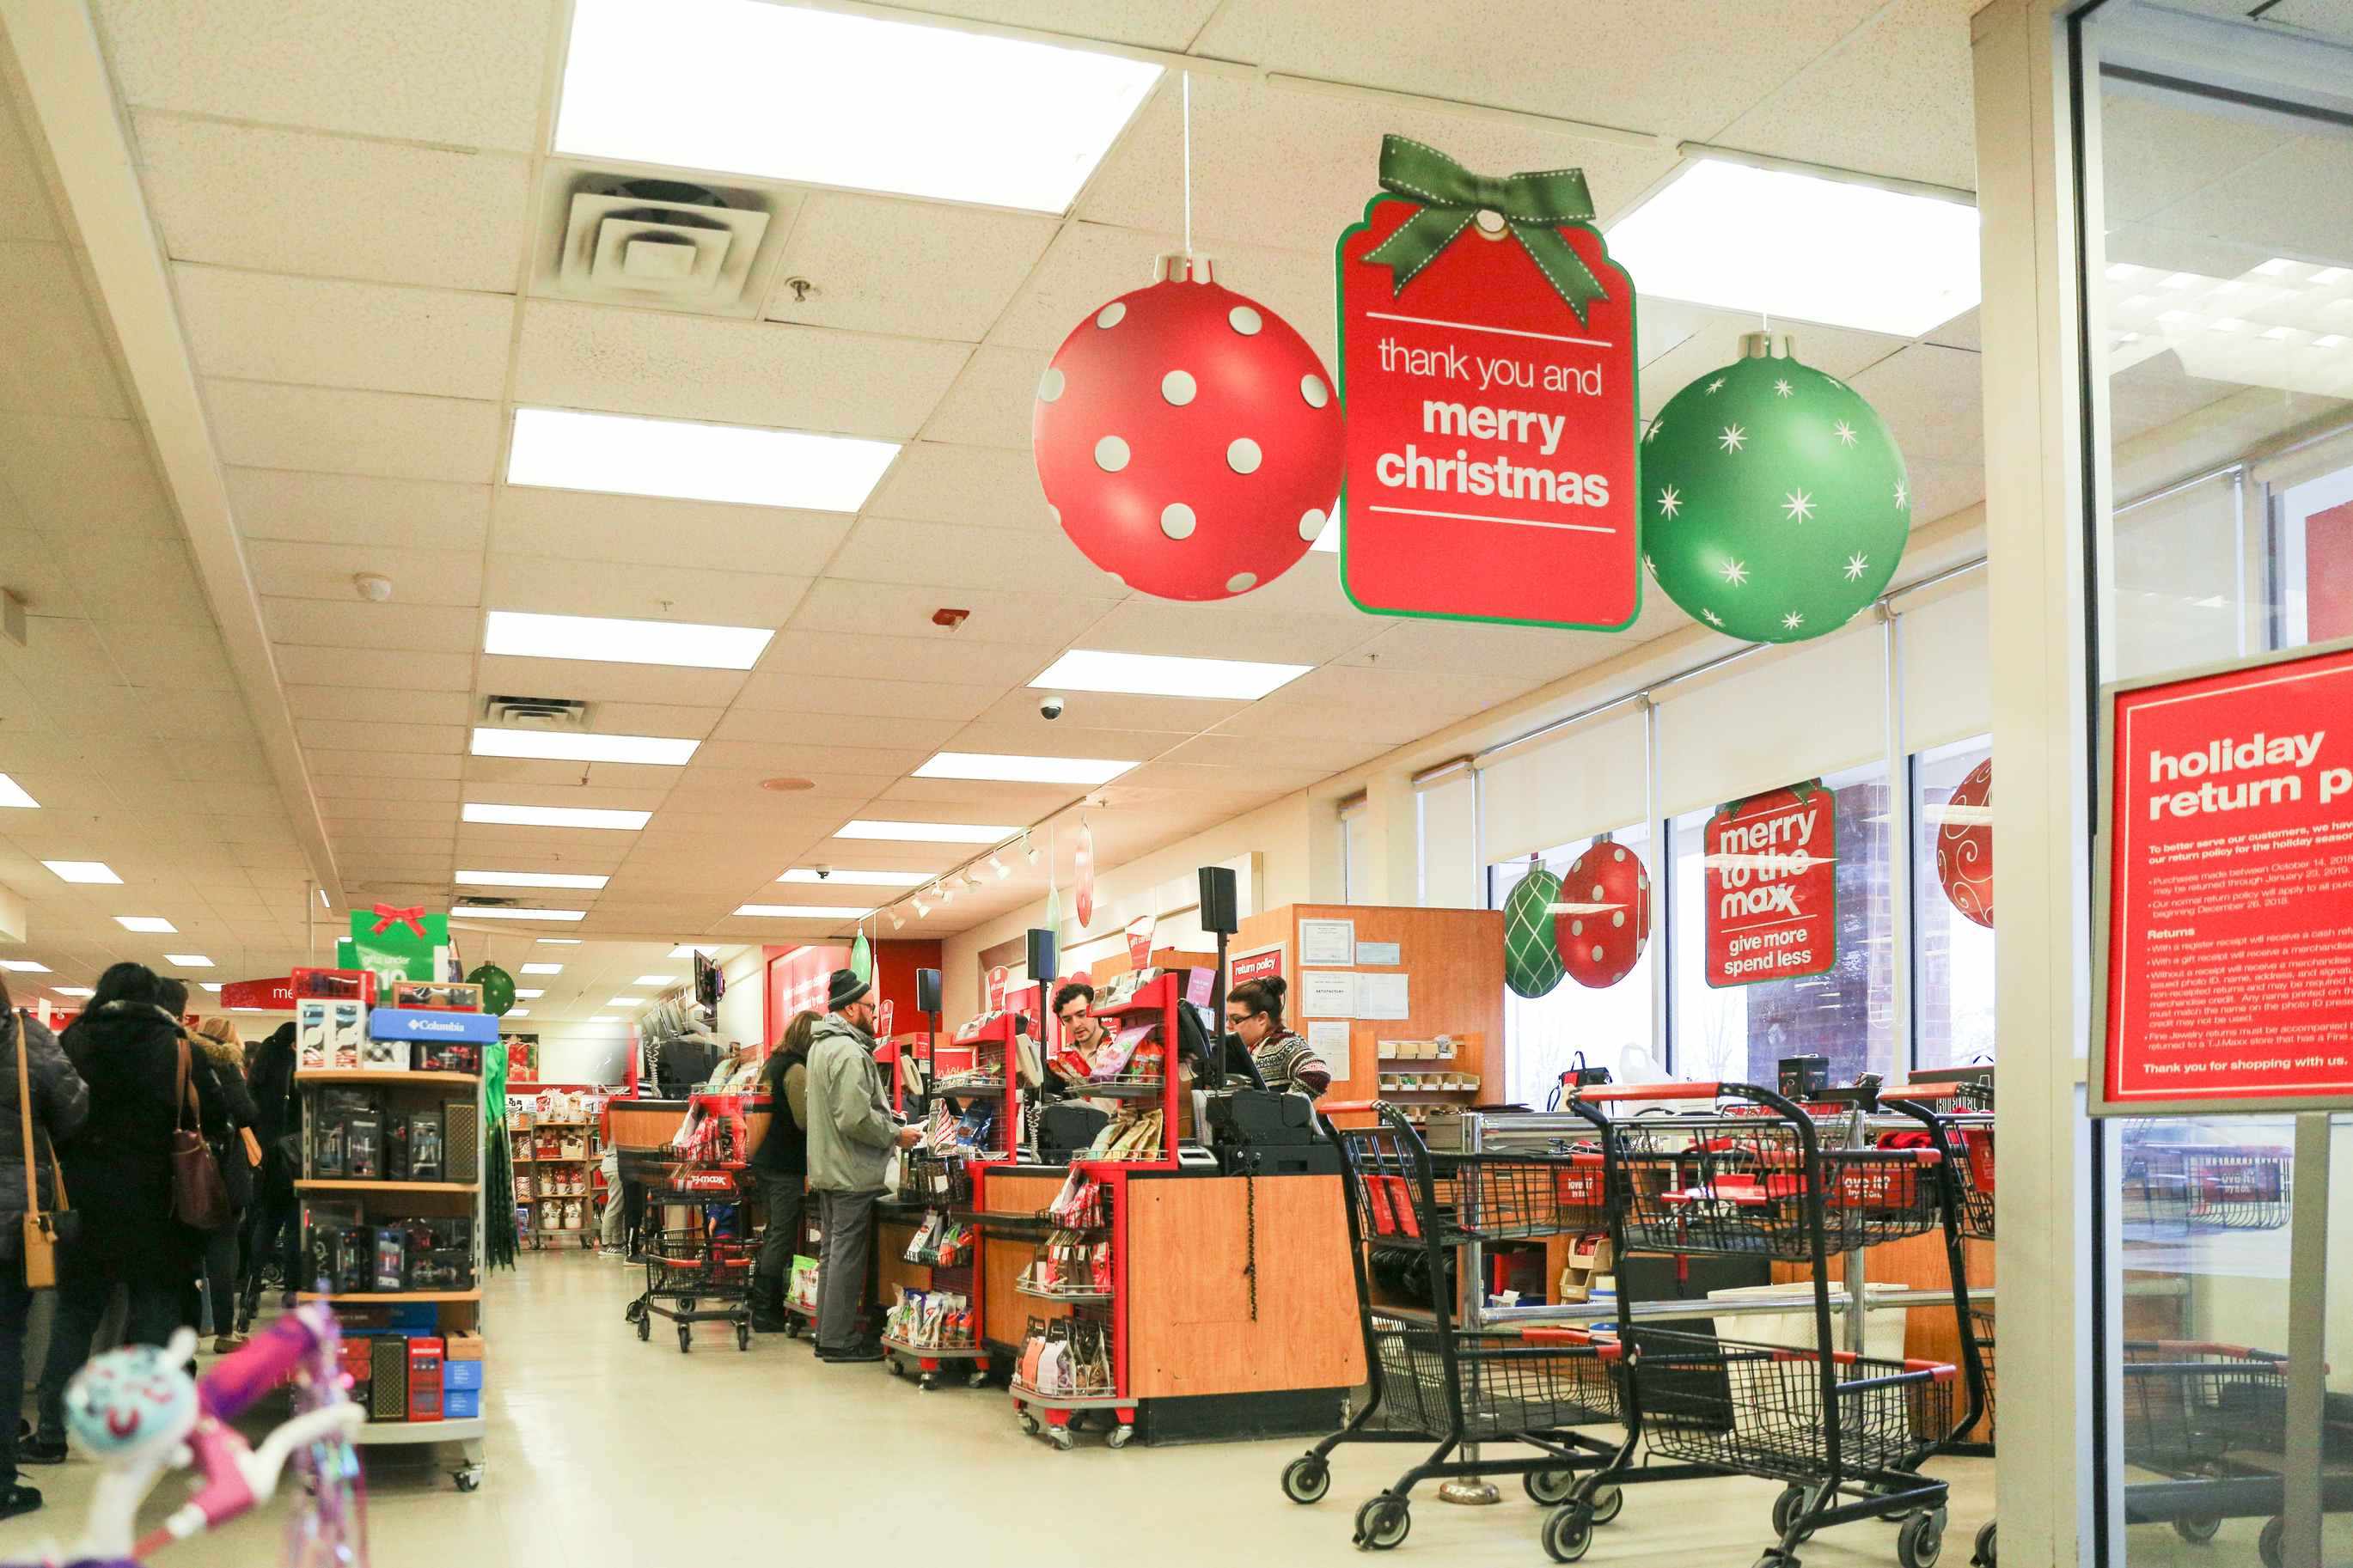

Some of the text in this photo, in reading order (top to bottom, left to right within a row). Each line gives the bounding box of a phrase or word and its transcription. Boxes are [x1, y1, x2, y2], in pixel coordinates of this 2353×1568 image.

[1378, 337, 1602, 396] thank you and
[1423, 400, 1566, 456] merry
[1376, 443, 1610, 508] christmas
[2149, 730, 2325, 784] holiday
[2149, 775, 2301, 821] return
[1720, 809, 1818, 855] merry
[2149, 845, 2161, 855] To
[2163, 841, 2195, 853] better
[2197, 839, 2225, 849] serve
[2228, 834, 2246, 845] our
[2248, 827, 2310, 842] customers,
[2312, 824, 2329, 833] we
[2148, 856, 2167, 865] our
[2168, 851, 2200, 863] return
[2202, 848, 2233, 860] policy
[2235, 845, 2250, 854] for
[2252, 843, 2270, 852] the
[2273, 838, 2313, 851] holiday
[1720, 848, 1810, 890] to the
[2265, 872, 2303, 883] January
[2271, 862, 2309, 872] October
[1720, 882, 1802, 919] maxx
[1729, 929, 1808, 957] give more
[2148, 928, 2196, 940] Returns
[1235, 957, 1276, 977] return policy
[1724, 949, 1812, 978] spend less
[419, 1020, 465, 1032] Columbia
[2143, 1055, 2349, 1075] Thank you for shopping with us.
